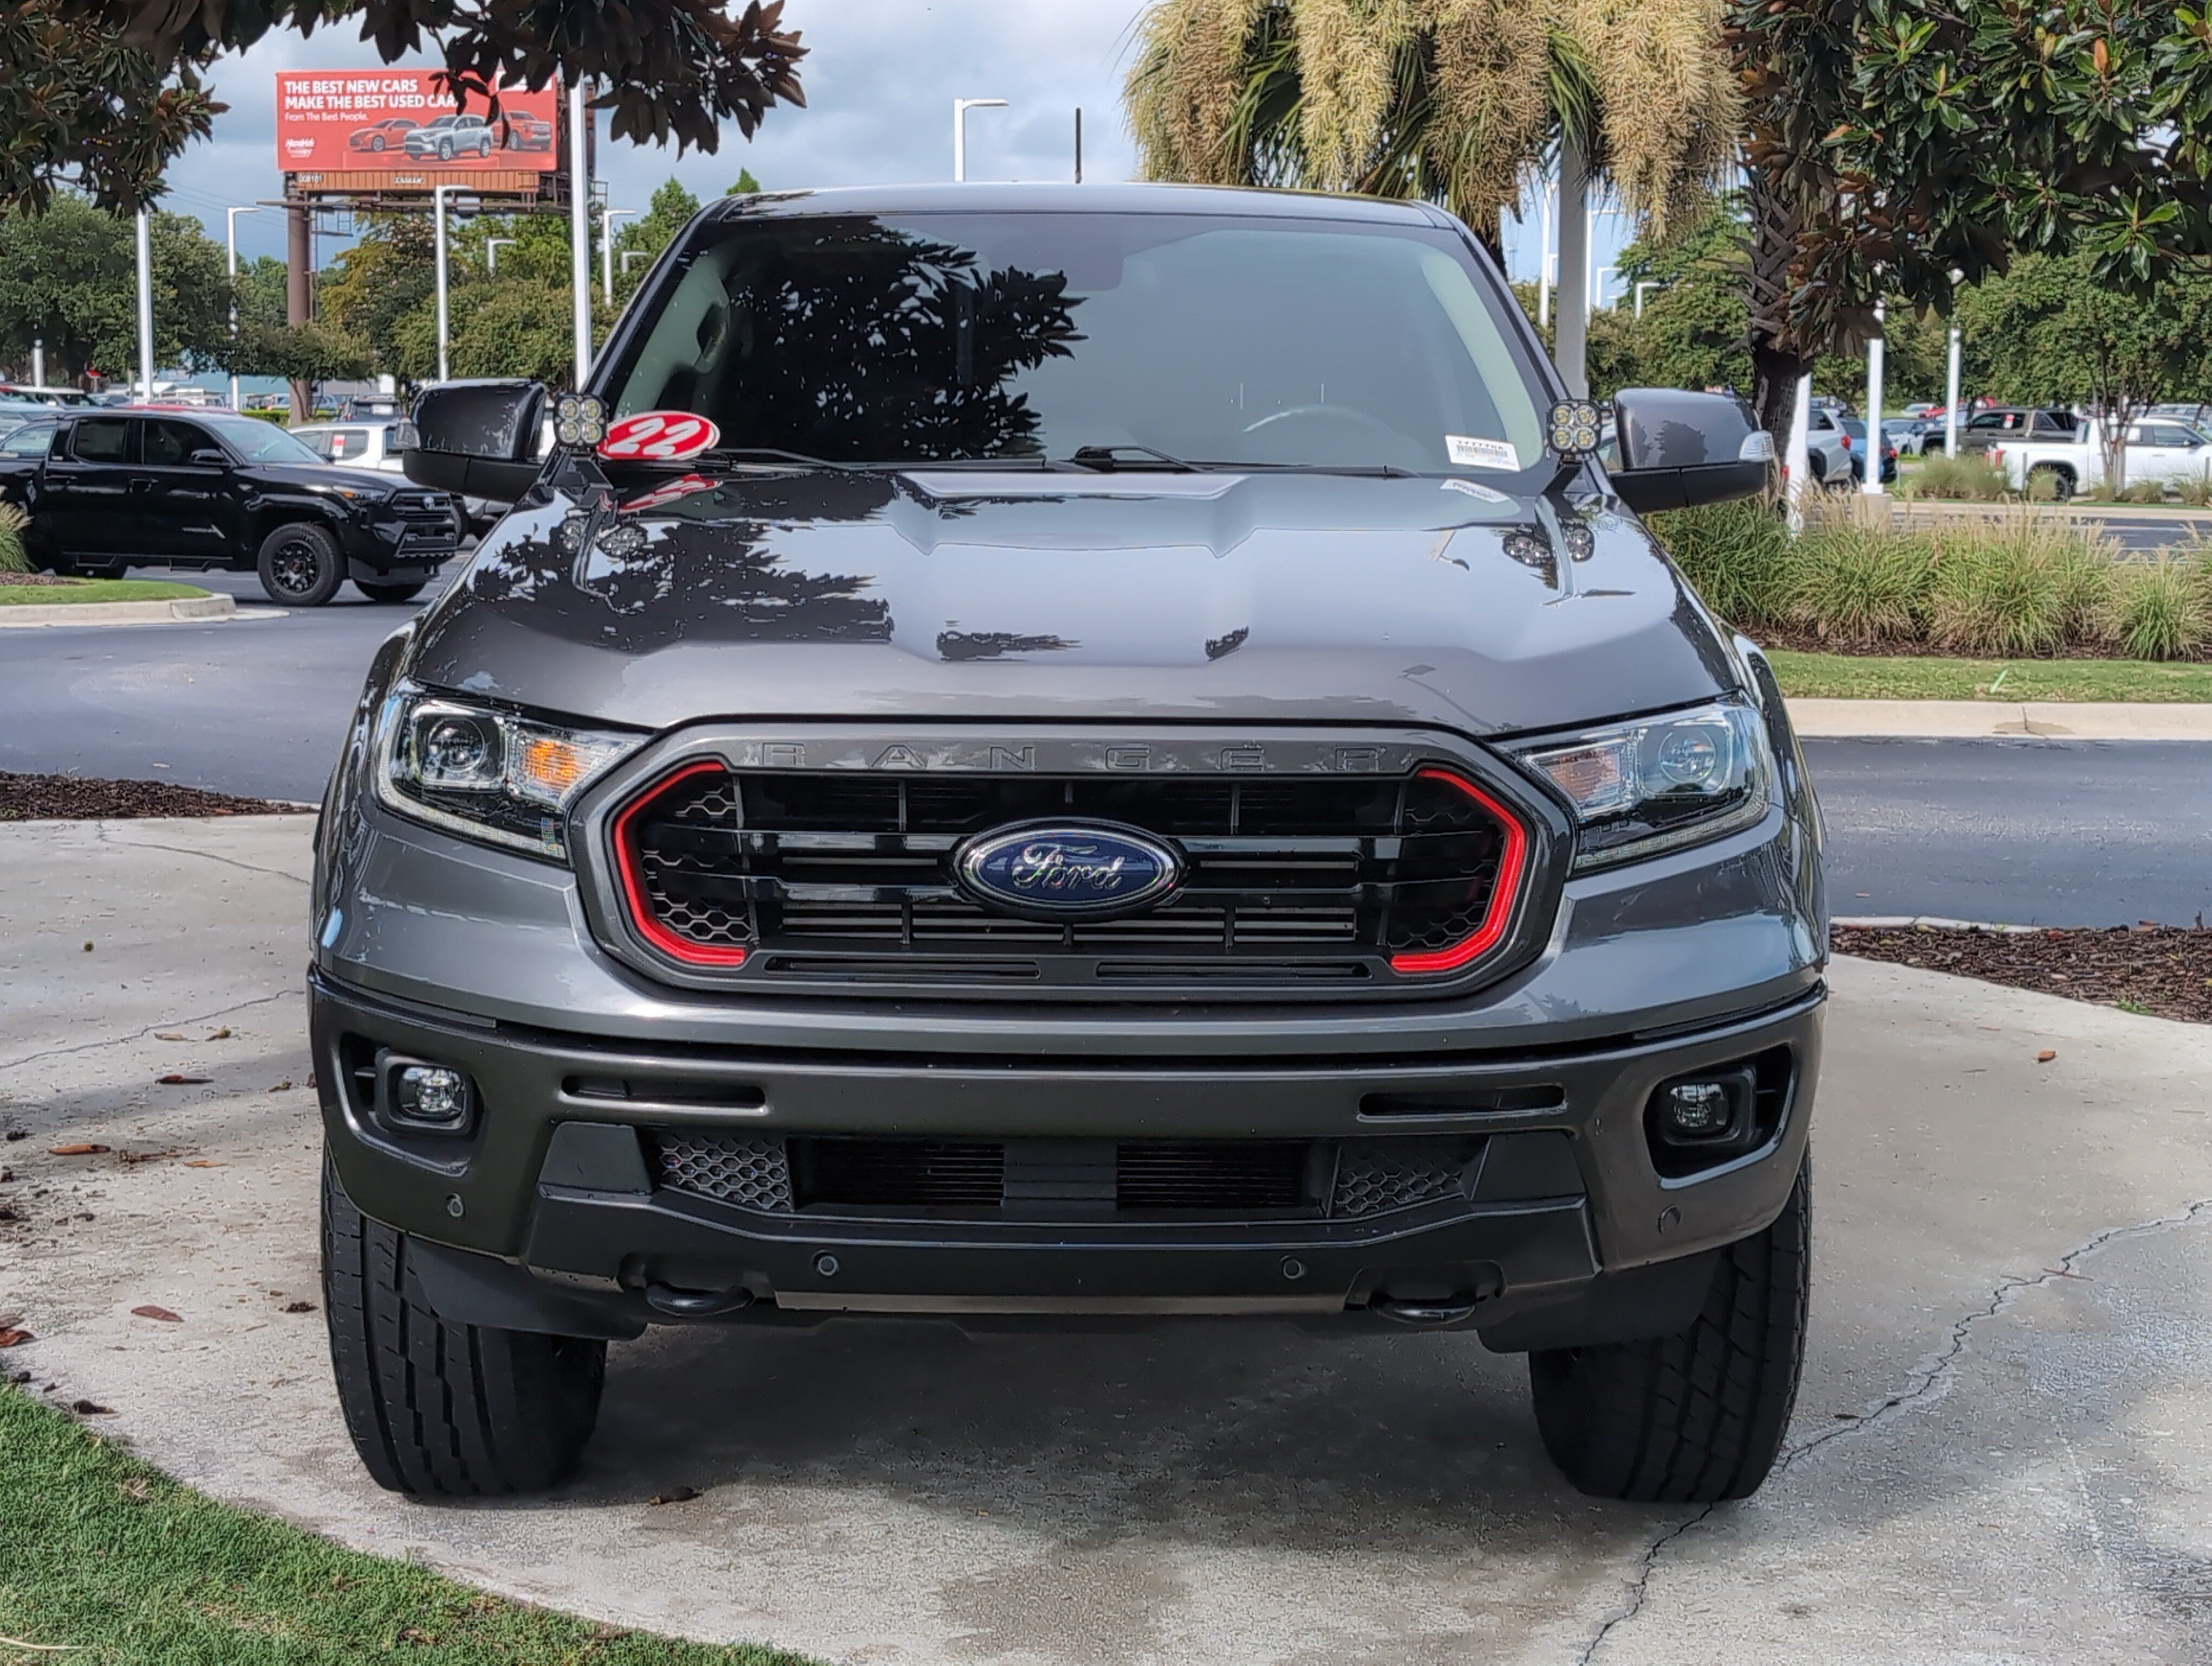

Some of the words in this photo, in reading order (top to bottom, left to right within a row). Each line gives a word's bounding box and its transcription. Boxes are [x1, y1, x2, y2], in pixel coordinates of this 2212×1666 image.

[285, 81, 310, 94] THE
[312, 80, 345, 94] BEST
[346, 80, 380, 93] NEW
[382, 79, 417, 93] CARS
[285, 96, 324, 109] MAKE
[326, 95, 351, 109] THE
[354, 95, 387, 108] BEST
[389, 94, 425, 108] USED
[285, 112, 305, 121] From
[306, 112, 320, 121] The
[321, 112, 339, 121] Best
[607, 417, 702, 456] 22
[761, 742, 1387, 771] RANGER
[1012, 841, 1128, 890] Ford
